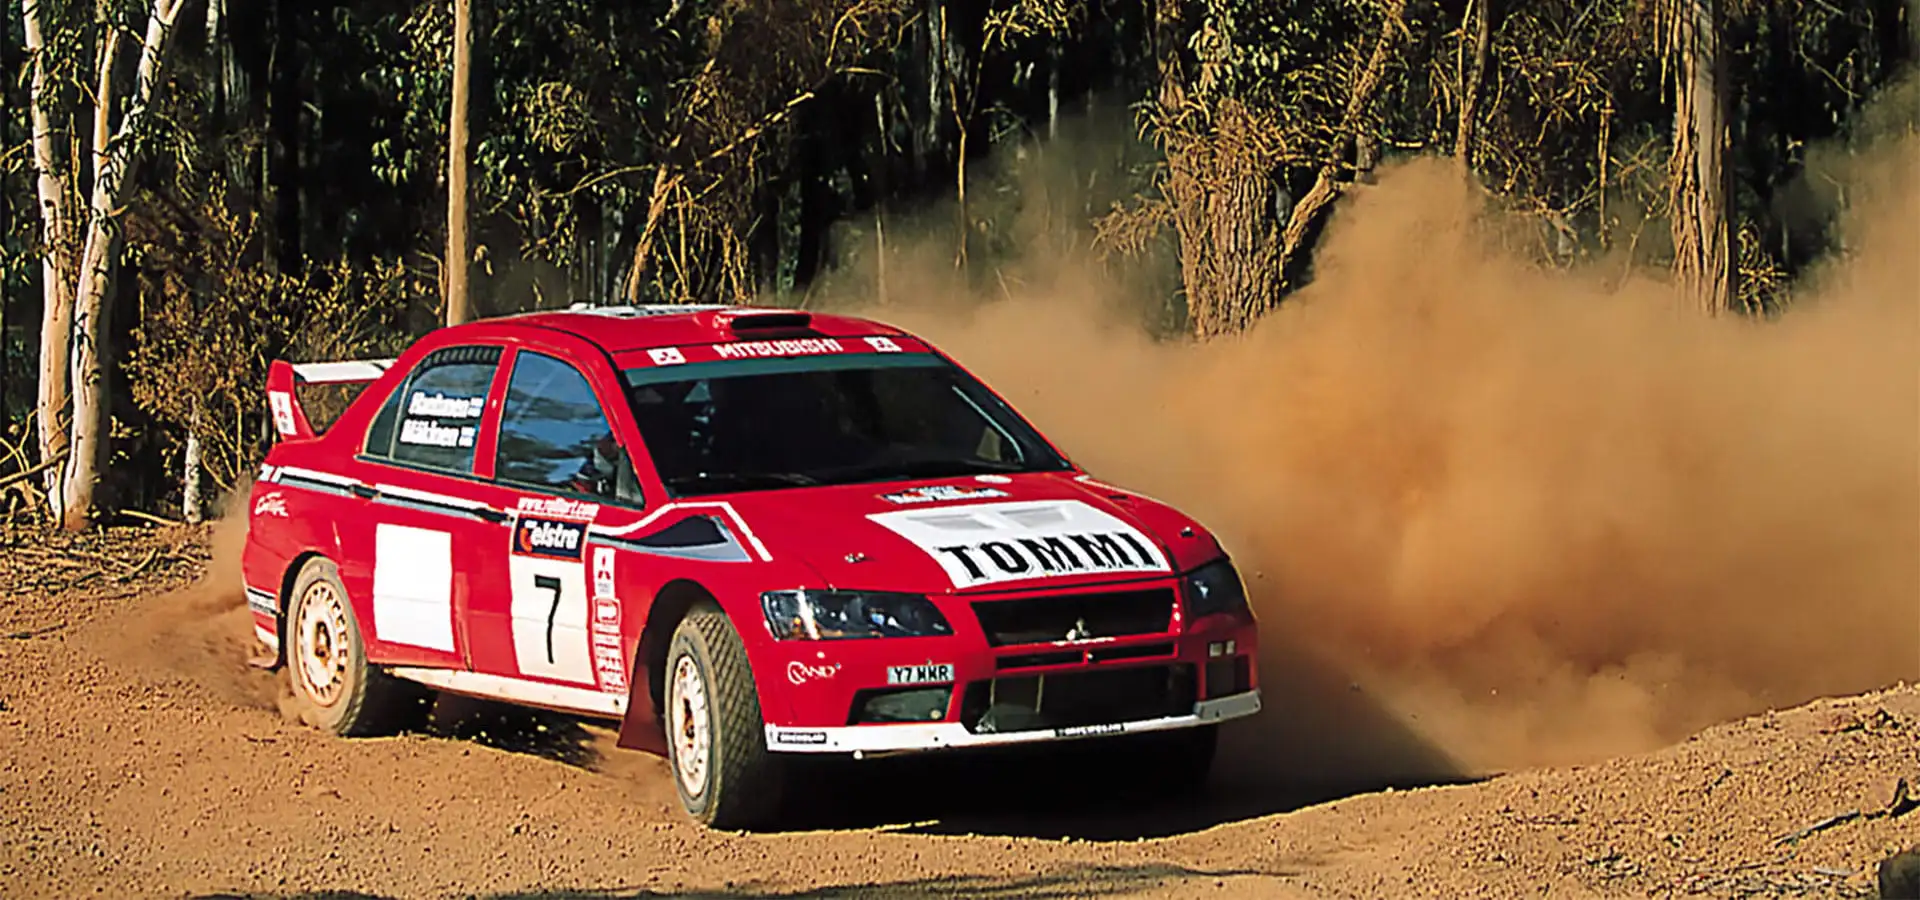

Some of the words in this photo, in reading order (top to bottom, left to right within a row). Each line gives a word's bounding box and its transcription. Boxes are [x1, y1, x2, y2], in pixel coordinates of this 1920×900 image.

[712, 338, 844, 359] MITSUBISHI
[520, 520, 581, 552] Telstra
[935, 532, 1164, 581] TOMMI
[534, 573, 562, 664] 7
[894, 666, 913, 683] Y7
